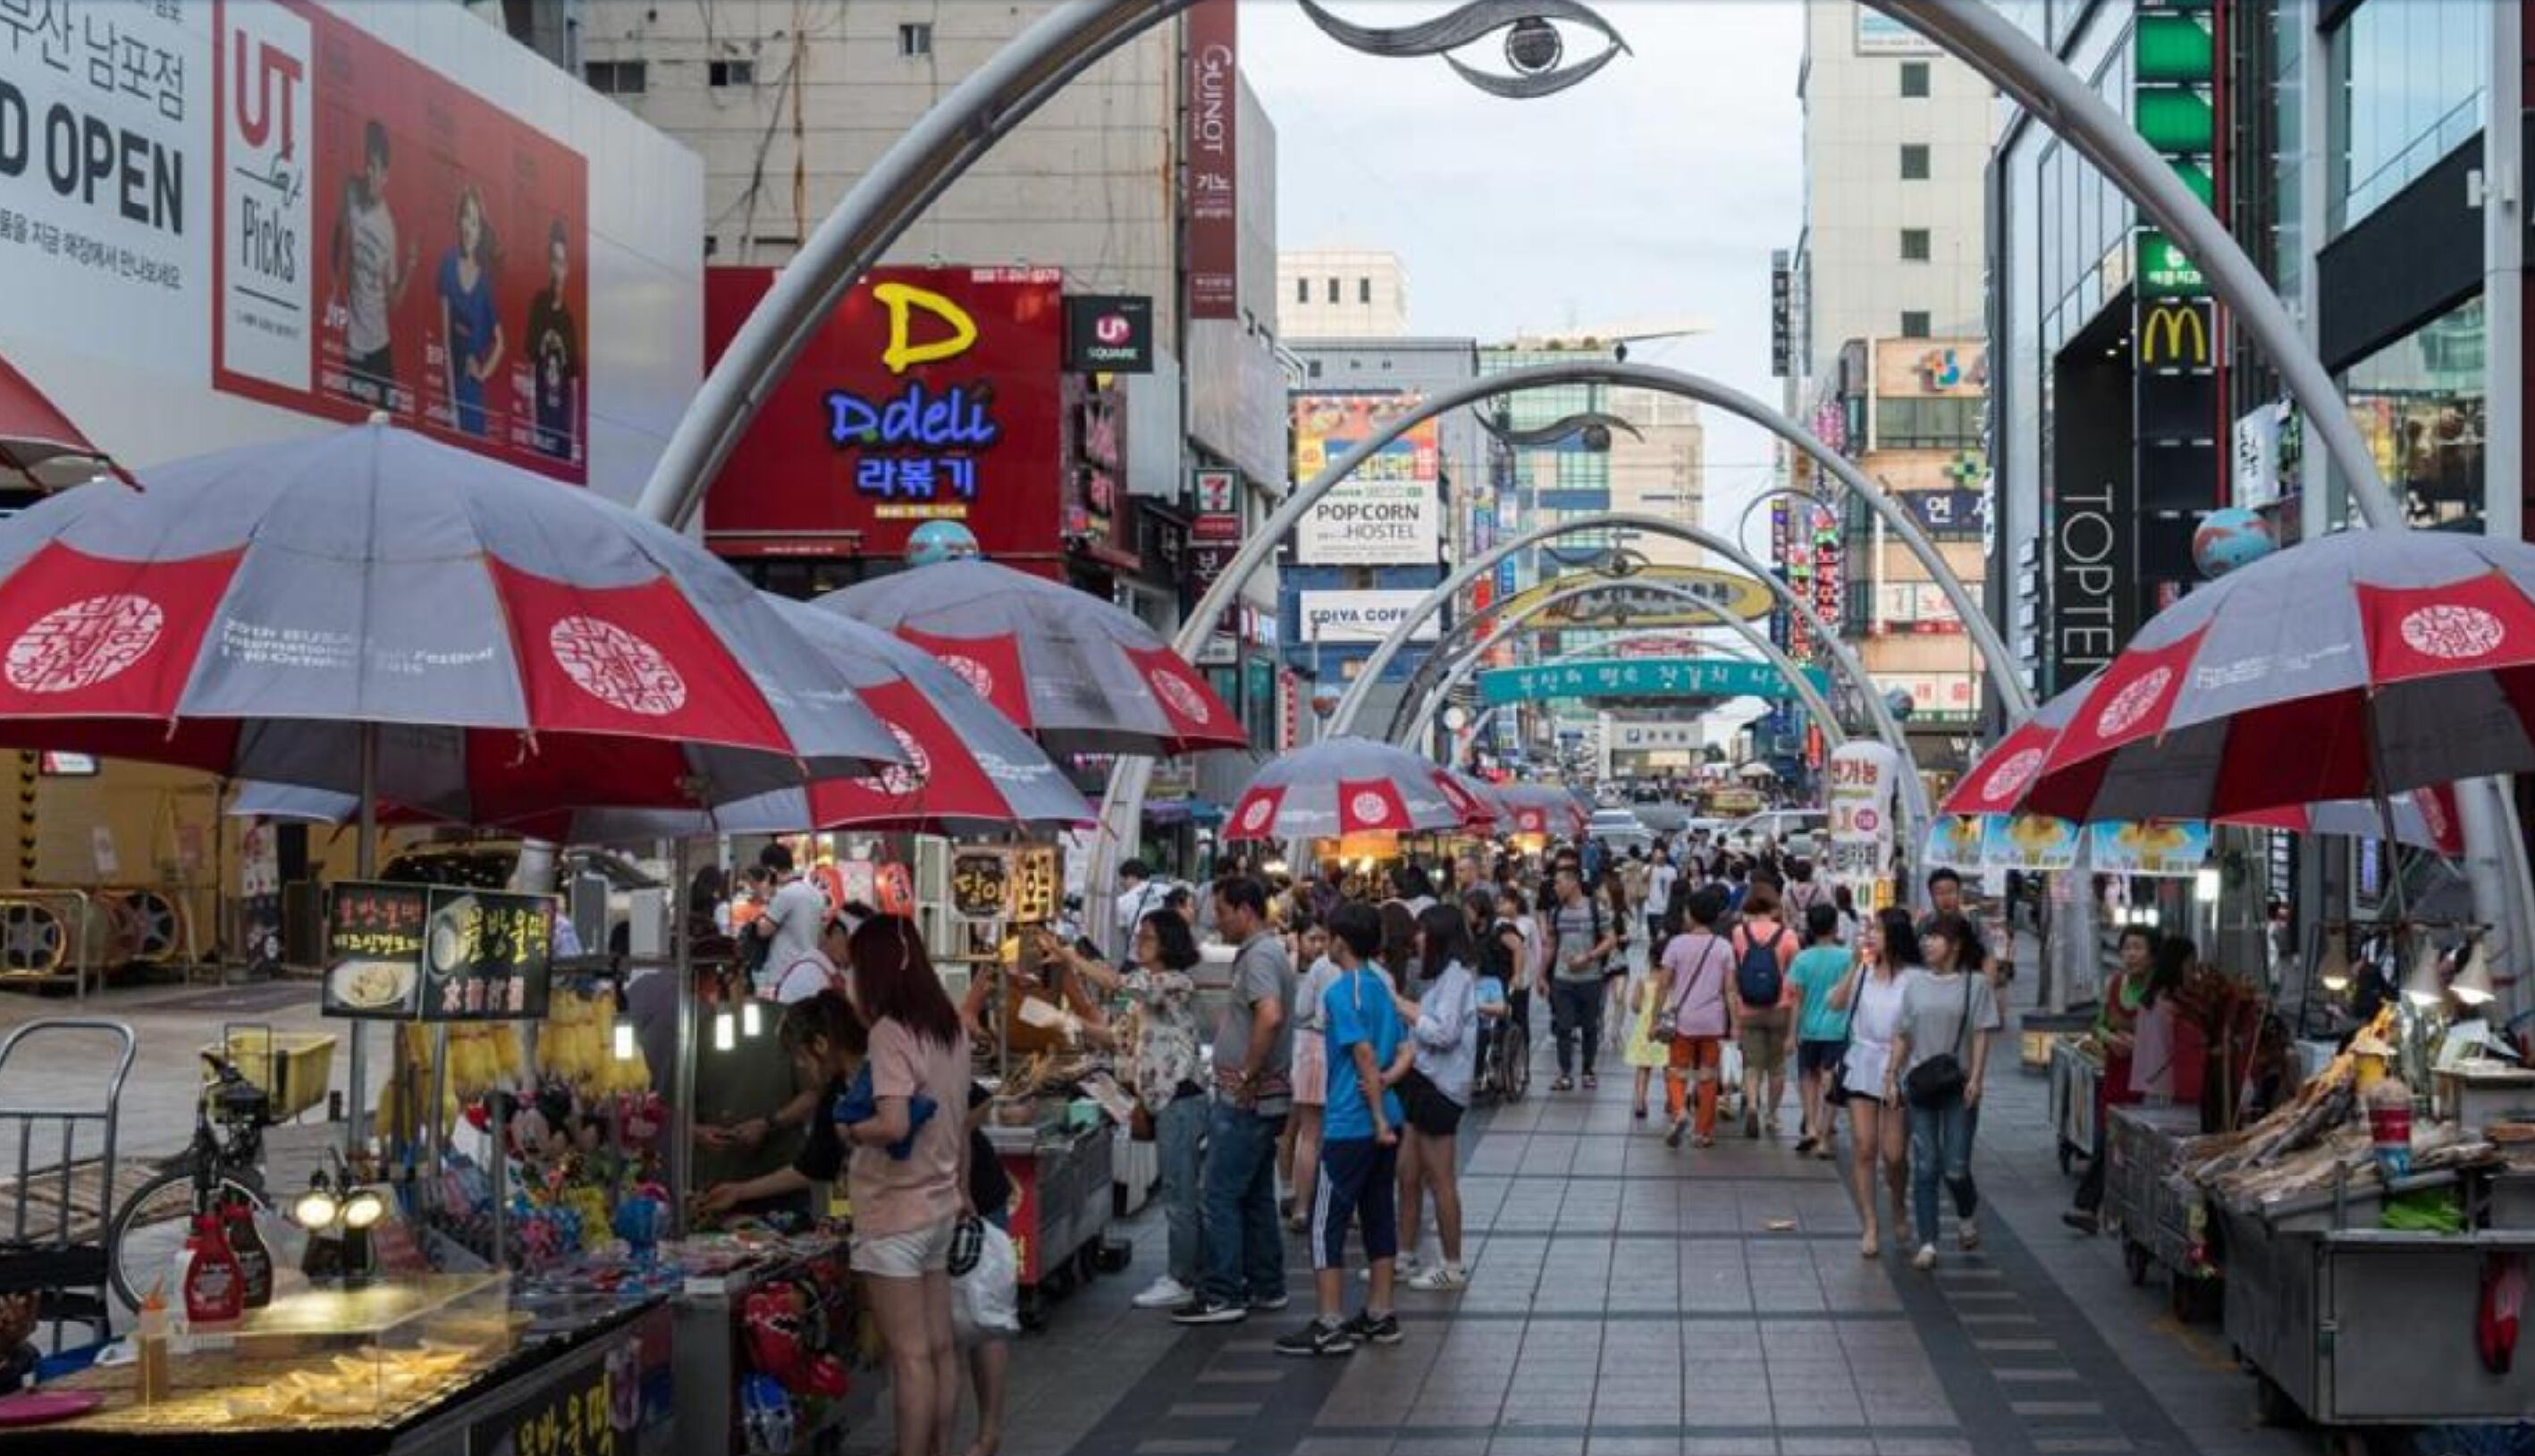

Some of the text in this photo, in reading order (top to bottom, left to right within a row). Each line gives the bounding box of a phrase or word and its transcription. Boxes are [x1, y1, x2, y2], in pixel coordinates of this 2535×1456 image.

[85, 13, 184, 122] 남포점
[234, 28, 304, 163] UT
[1202, 46, 1232, 156] GUINOT
[46, 102, 183, 236] OPEN
[32, 221, 59, 256] 지금
[242, 194, 295, 283] Picks
[872, 283, 978, 374] D
[829, 383, 996, 444] Ddeli
[1317, 504, 1419, 521] POPCORN
[1347, 524, 1415, 539] HOSTEL
[1310, 608, 1410, 624] EDIYA COFF
